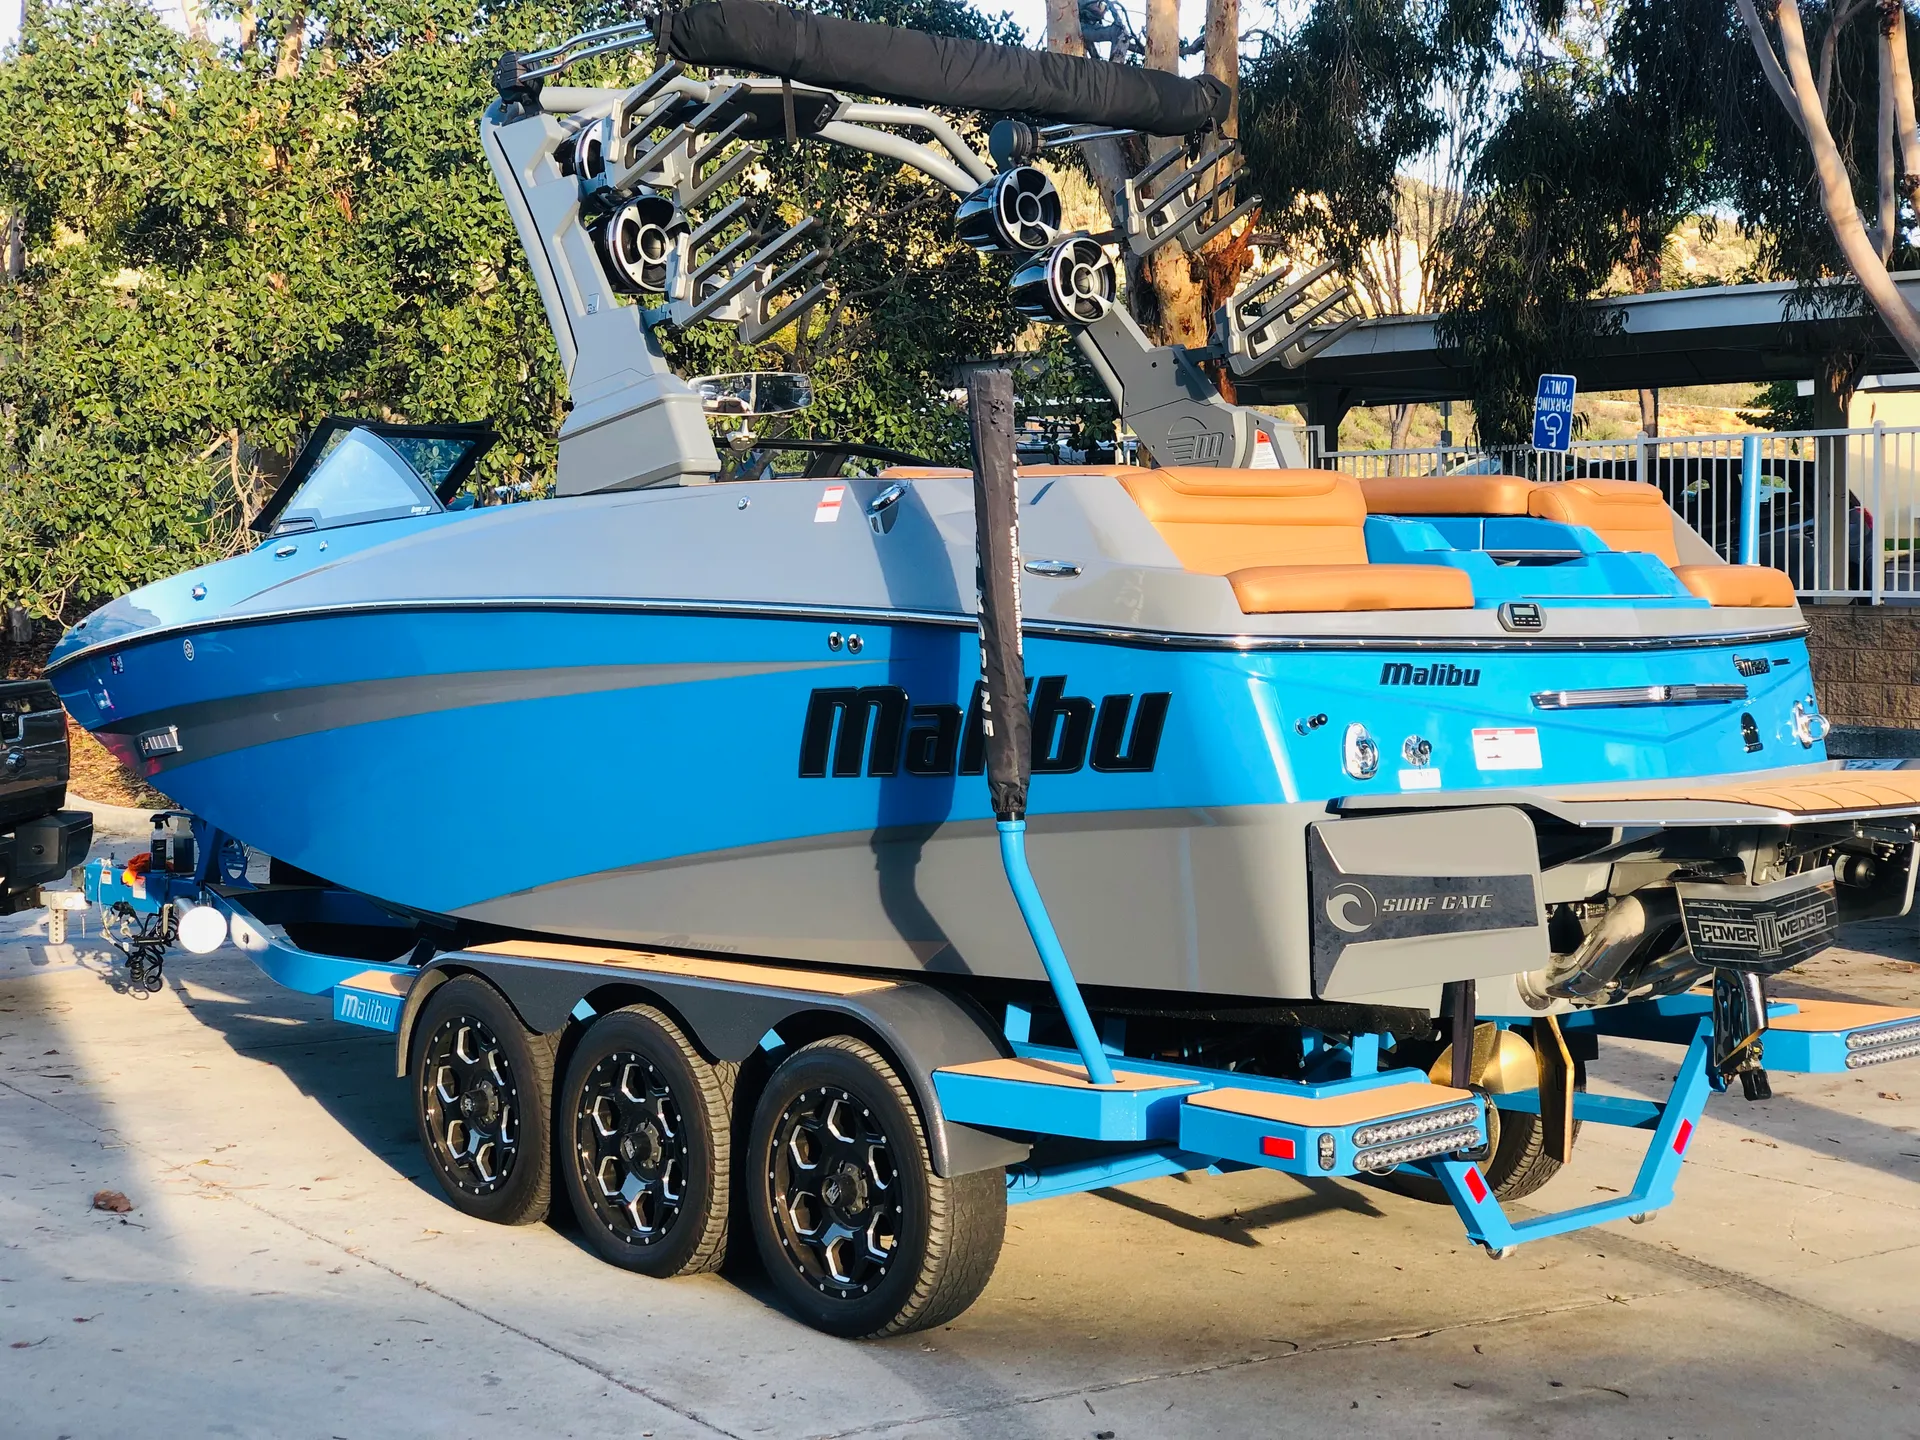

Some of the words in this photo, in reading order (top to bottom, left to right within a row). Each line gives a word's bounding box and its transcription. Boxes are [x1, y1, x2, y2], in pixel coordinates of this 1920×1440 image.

[1544, 380, 1568, 395] ONLY
[1538, 396, 1572, 413] PARKING
[1379, 662, 1482, 687] Malibu
[798, 674, 1173, 779] Malbu
[1382, 896, 1437, 912] SURF
[1441, 894, 1496, 910] GATE
[1700, 923, 1758, 943] POWER
[1777, 909, 1826, 939] WEDGE
[340, 993, 393, 1025] Malibu
